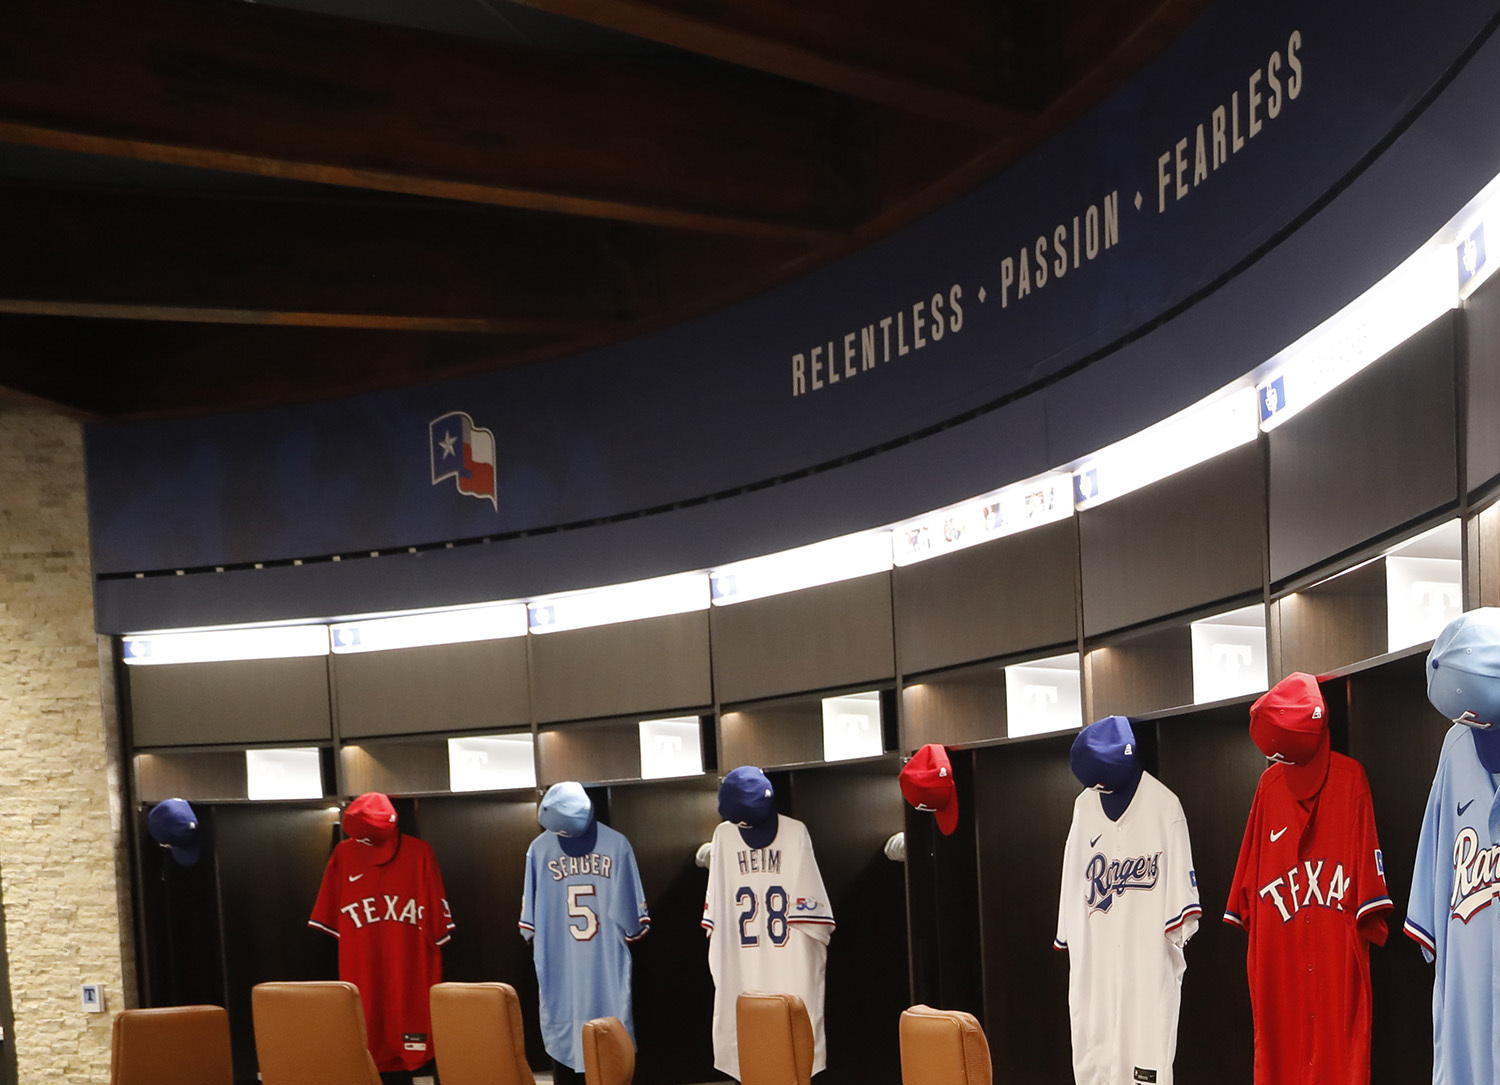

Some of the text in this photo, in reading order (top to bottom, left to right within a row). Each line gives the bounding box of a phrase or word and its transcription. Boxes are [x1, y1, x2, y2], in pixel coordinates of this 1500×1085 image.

[792, 29, 1302, 396] RELENTLESS PASSION FEARLESS
[737, 849, 782, 875] HEIM
[567, 884, 599, 941] 5
[736, 885, 791, 948] 28
